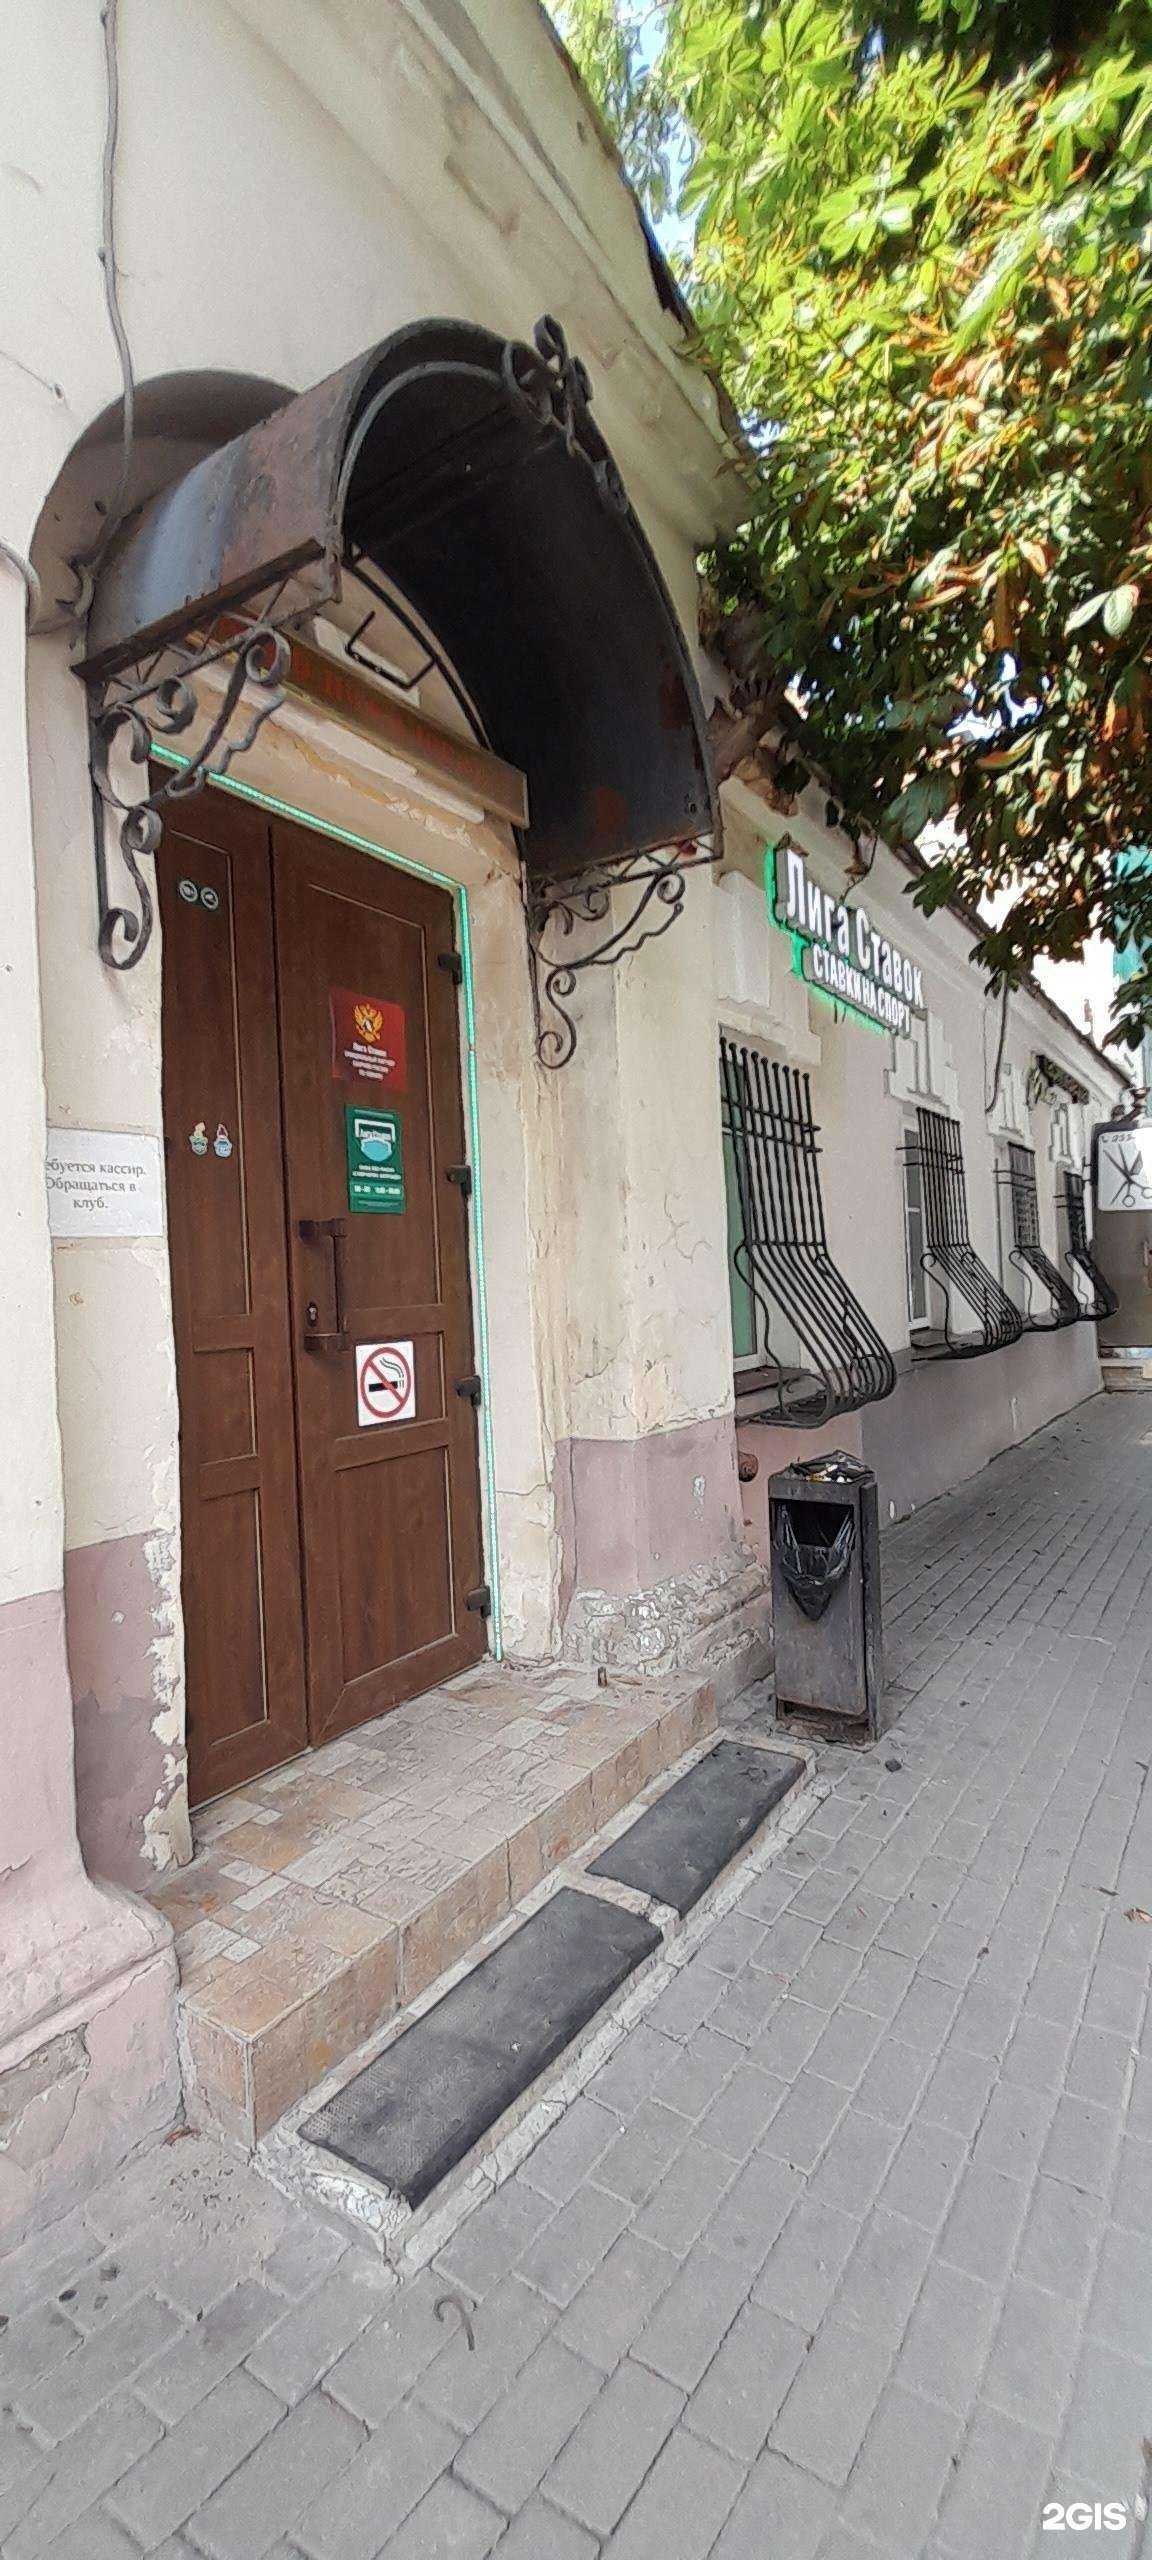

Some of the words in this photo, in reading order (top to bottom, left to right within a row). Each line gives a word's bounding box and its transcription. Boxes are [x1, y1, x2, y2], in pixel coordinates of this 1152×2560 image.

[787, 849, 850, 956] Лига
[856, 906, 923, 1009] Ставок
[812, 943, 862, 1004] СТАВКИ
[862, 975, 877, 1014] НА
[877, 986, 909, 1033] СПОРТ
[100, 1163, 146, 1178] кассир.
[129, 1183, 137, 1192] в
[73, 1196, 108, 1211] клуб.
